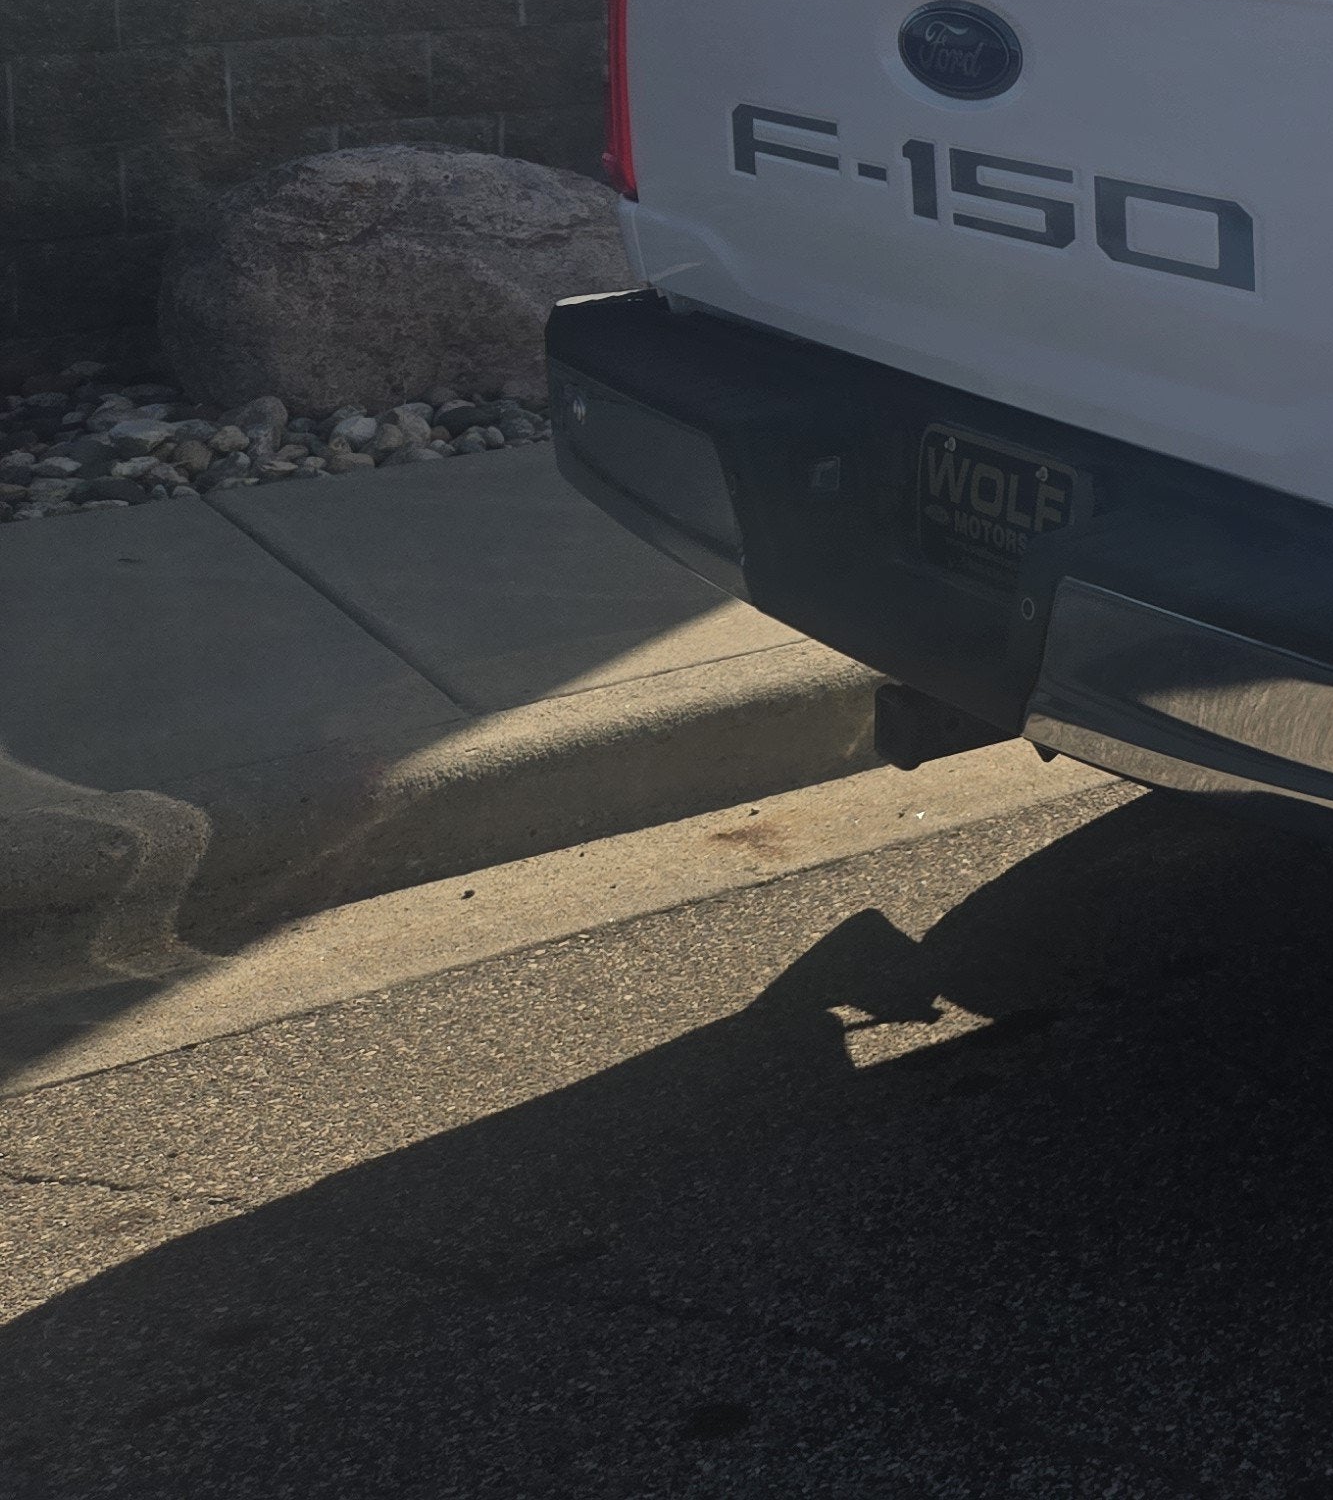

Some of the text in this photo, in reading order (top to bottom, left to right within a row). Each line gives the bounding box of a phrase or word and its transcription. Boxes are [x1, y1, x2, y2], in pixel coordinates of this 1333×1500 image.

[919, 21, 983, 77] Ford
[731, 104, 1256, 292] F-150
[927, 446, 1065, 532] WOLF
[955, 509, 1028, 553] MOTORS
